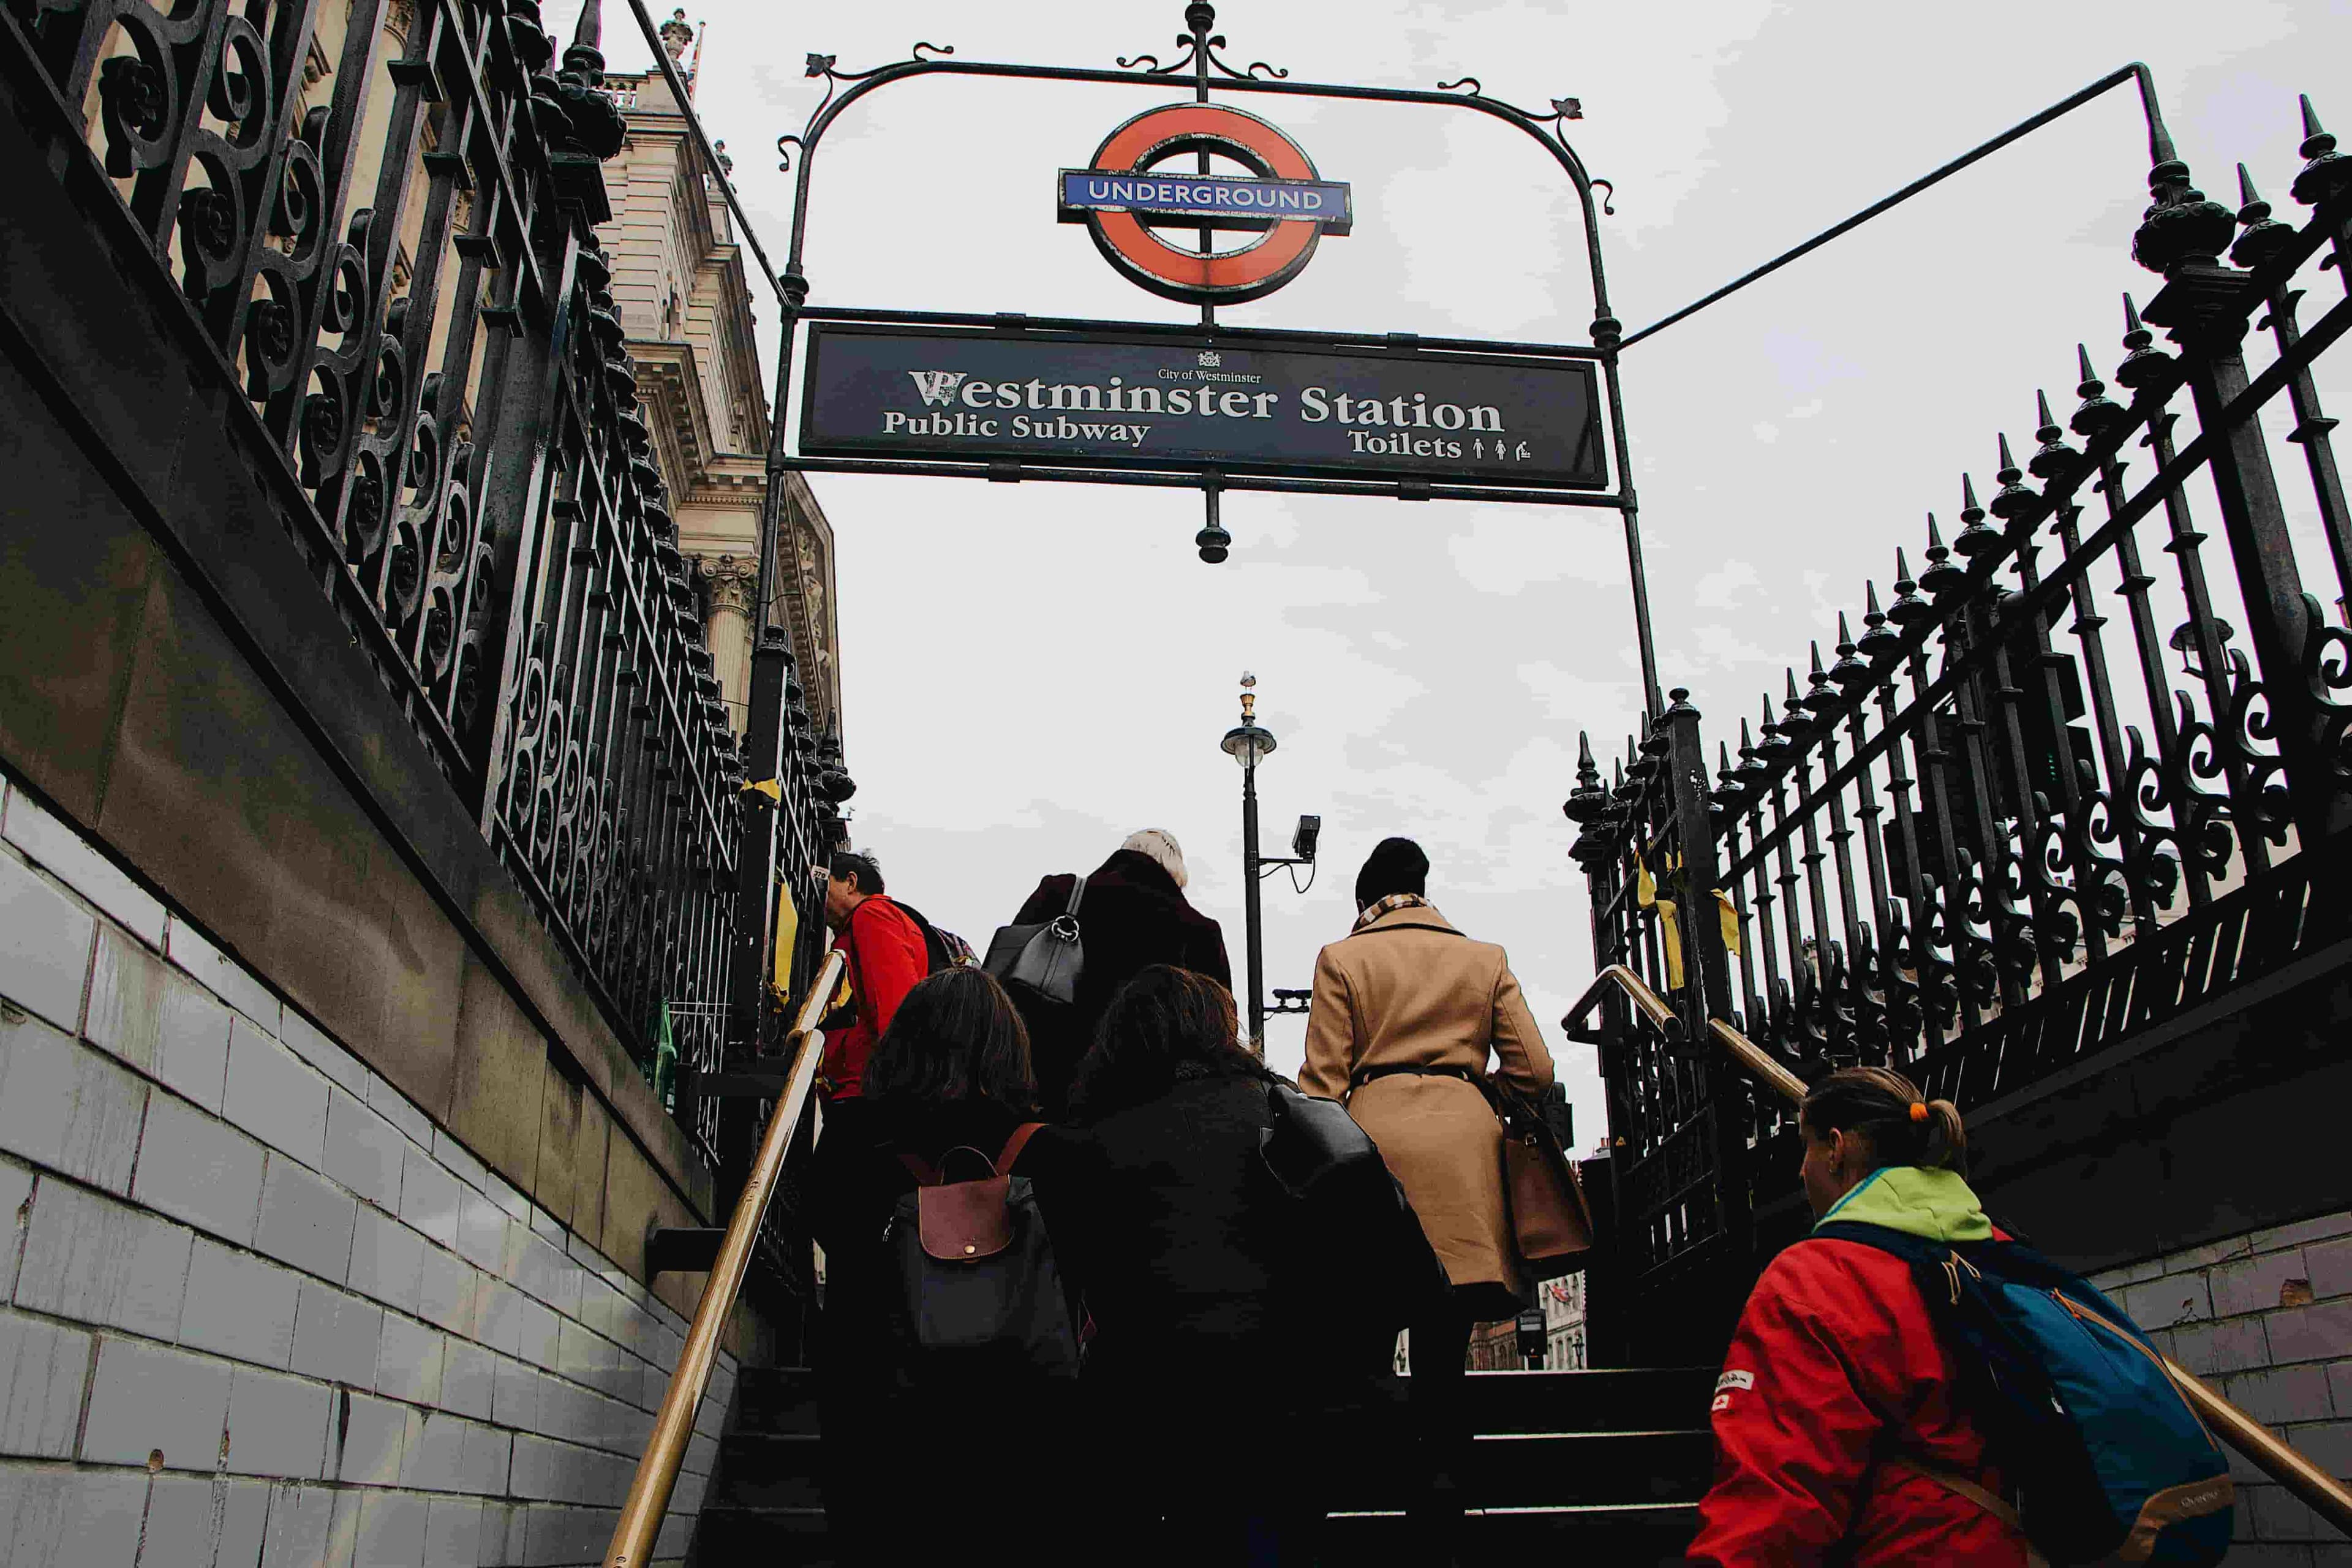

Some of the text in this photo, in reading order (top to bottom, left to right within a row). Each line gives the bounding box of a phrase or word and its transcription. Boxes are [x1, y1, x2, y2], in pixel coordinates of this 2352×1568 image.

[1088, 181, 1323, 209] UNDERGROUND
[1158, 368, 1262, 383] City of Westminster
[908, 369, 1506, 432] Westminster Station
[882, 411, 1152, 448] Public Subway
[1346, 429, 1463, 459] Toilets
